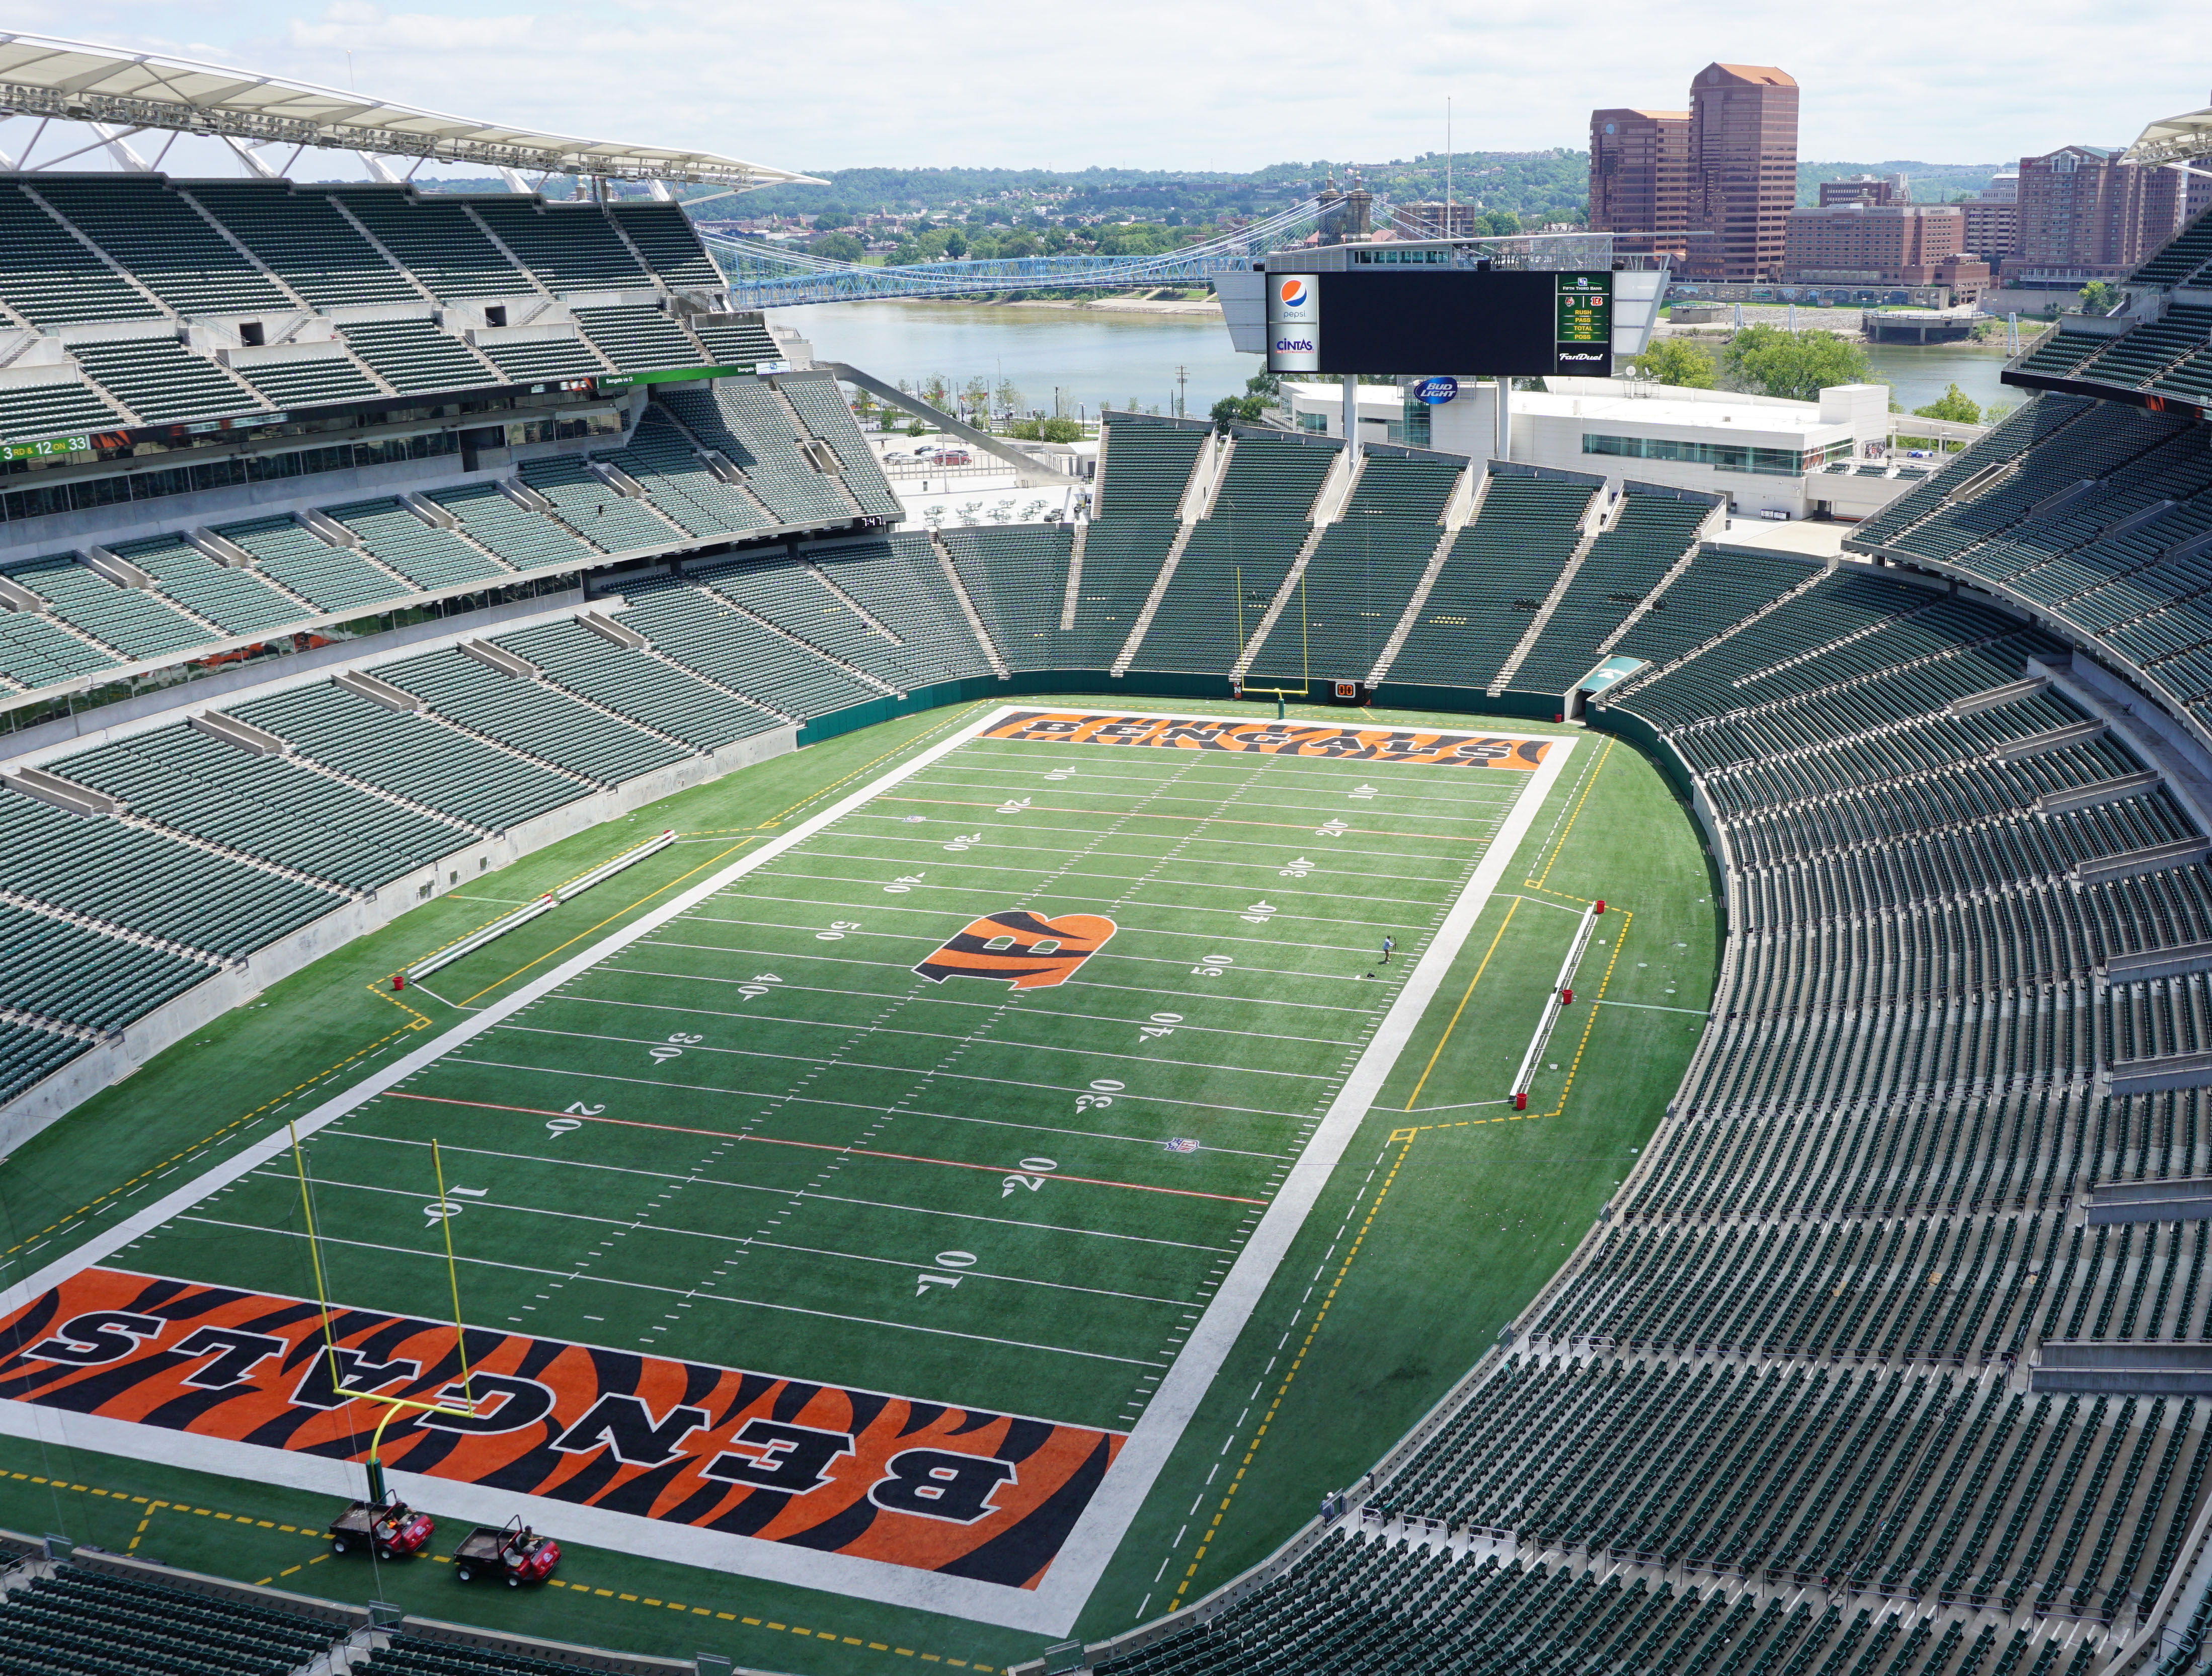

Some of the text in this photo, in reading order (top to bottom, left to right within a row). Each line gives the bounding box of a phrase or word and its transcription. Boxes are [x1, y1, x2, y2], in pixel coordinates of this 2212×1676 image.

[1283, 310, 1306, 319] pepsi
[1276, 338, 1313, 351] CINTAS
[1559, 353, 1603, 361] FanDuel
[36, 441, 53, 455] 12
[53, 442, 66, 450] ON
[68, 437, 86, 451] 33
[861, 516, 882, 527] 7:47
[1338, 684, 1353, 695] 00
[1022, 720, 1512, 759] BENGALS
[1044, 768, 1076, 780] 10
[1348, 787, 1379, 800] 10
[996, 800, 1031, 814] 20
[1315, 822, 1349, 837] 20
[942, 835, 981, 851] 30
[1279, 860, 1315, 877] 30
[883, 876, 922, 893] 40
[1240, 905, 1277, 924] 40
[815, 921, 861, 940] 50
[1190, 955, 1233, 977] 50
[737, 973, 783, 995] 40
[1140, 1013, 1183, 1037] 40
[649, 1032, 703, 1058] 30
[1075, 1079, 1126, 1108] 30
[545, 1101, 605, 1131] 20
[1002, 1157, 1058, 1191] 20
[423, 1184, 489, 1217] 10
[917, 1251, 977, 1289] 10
[21, 1310, 1018, 1525] BENGALS
